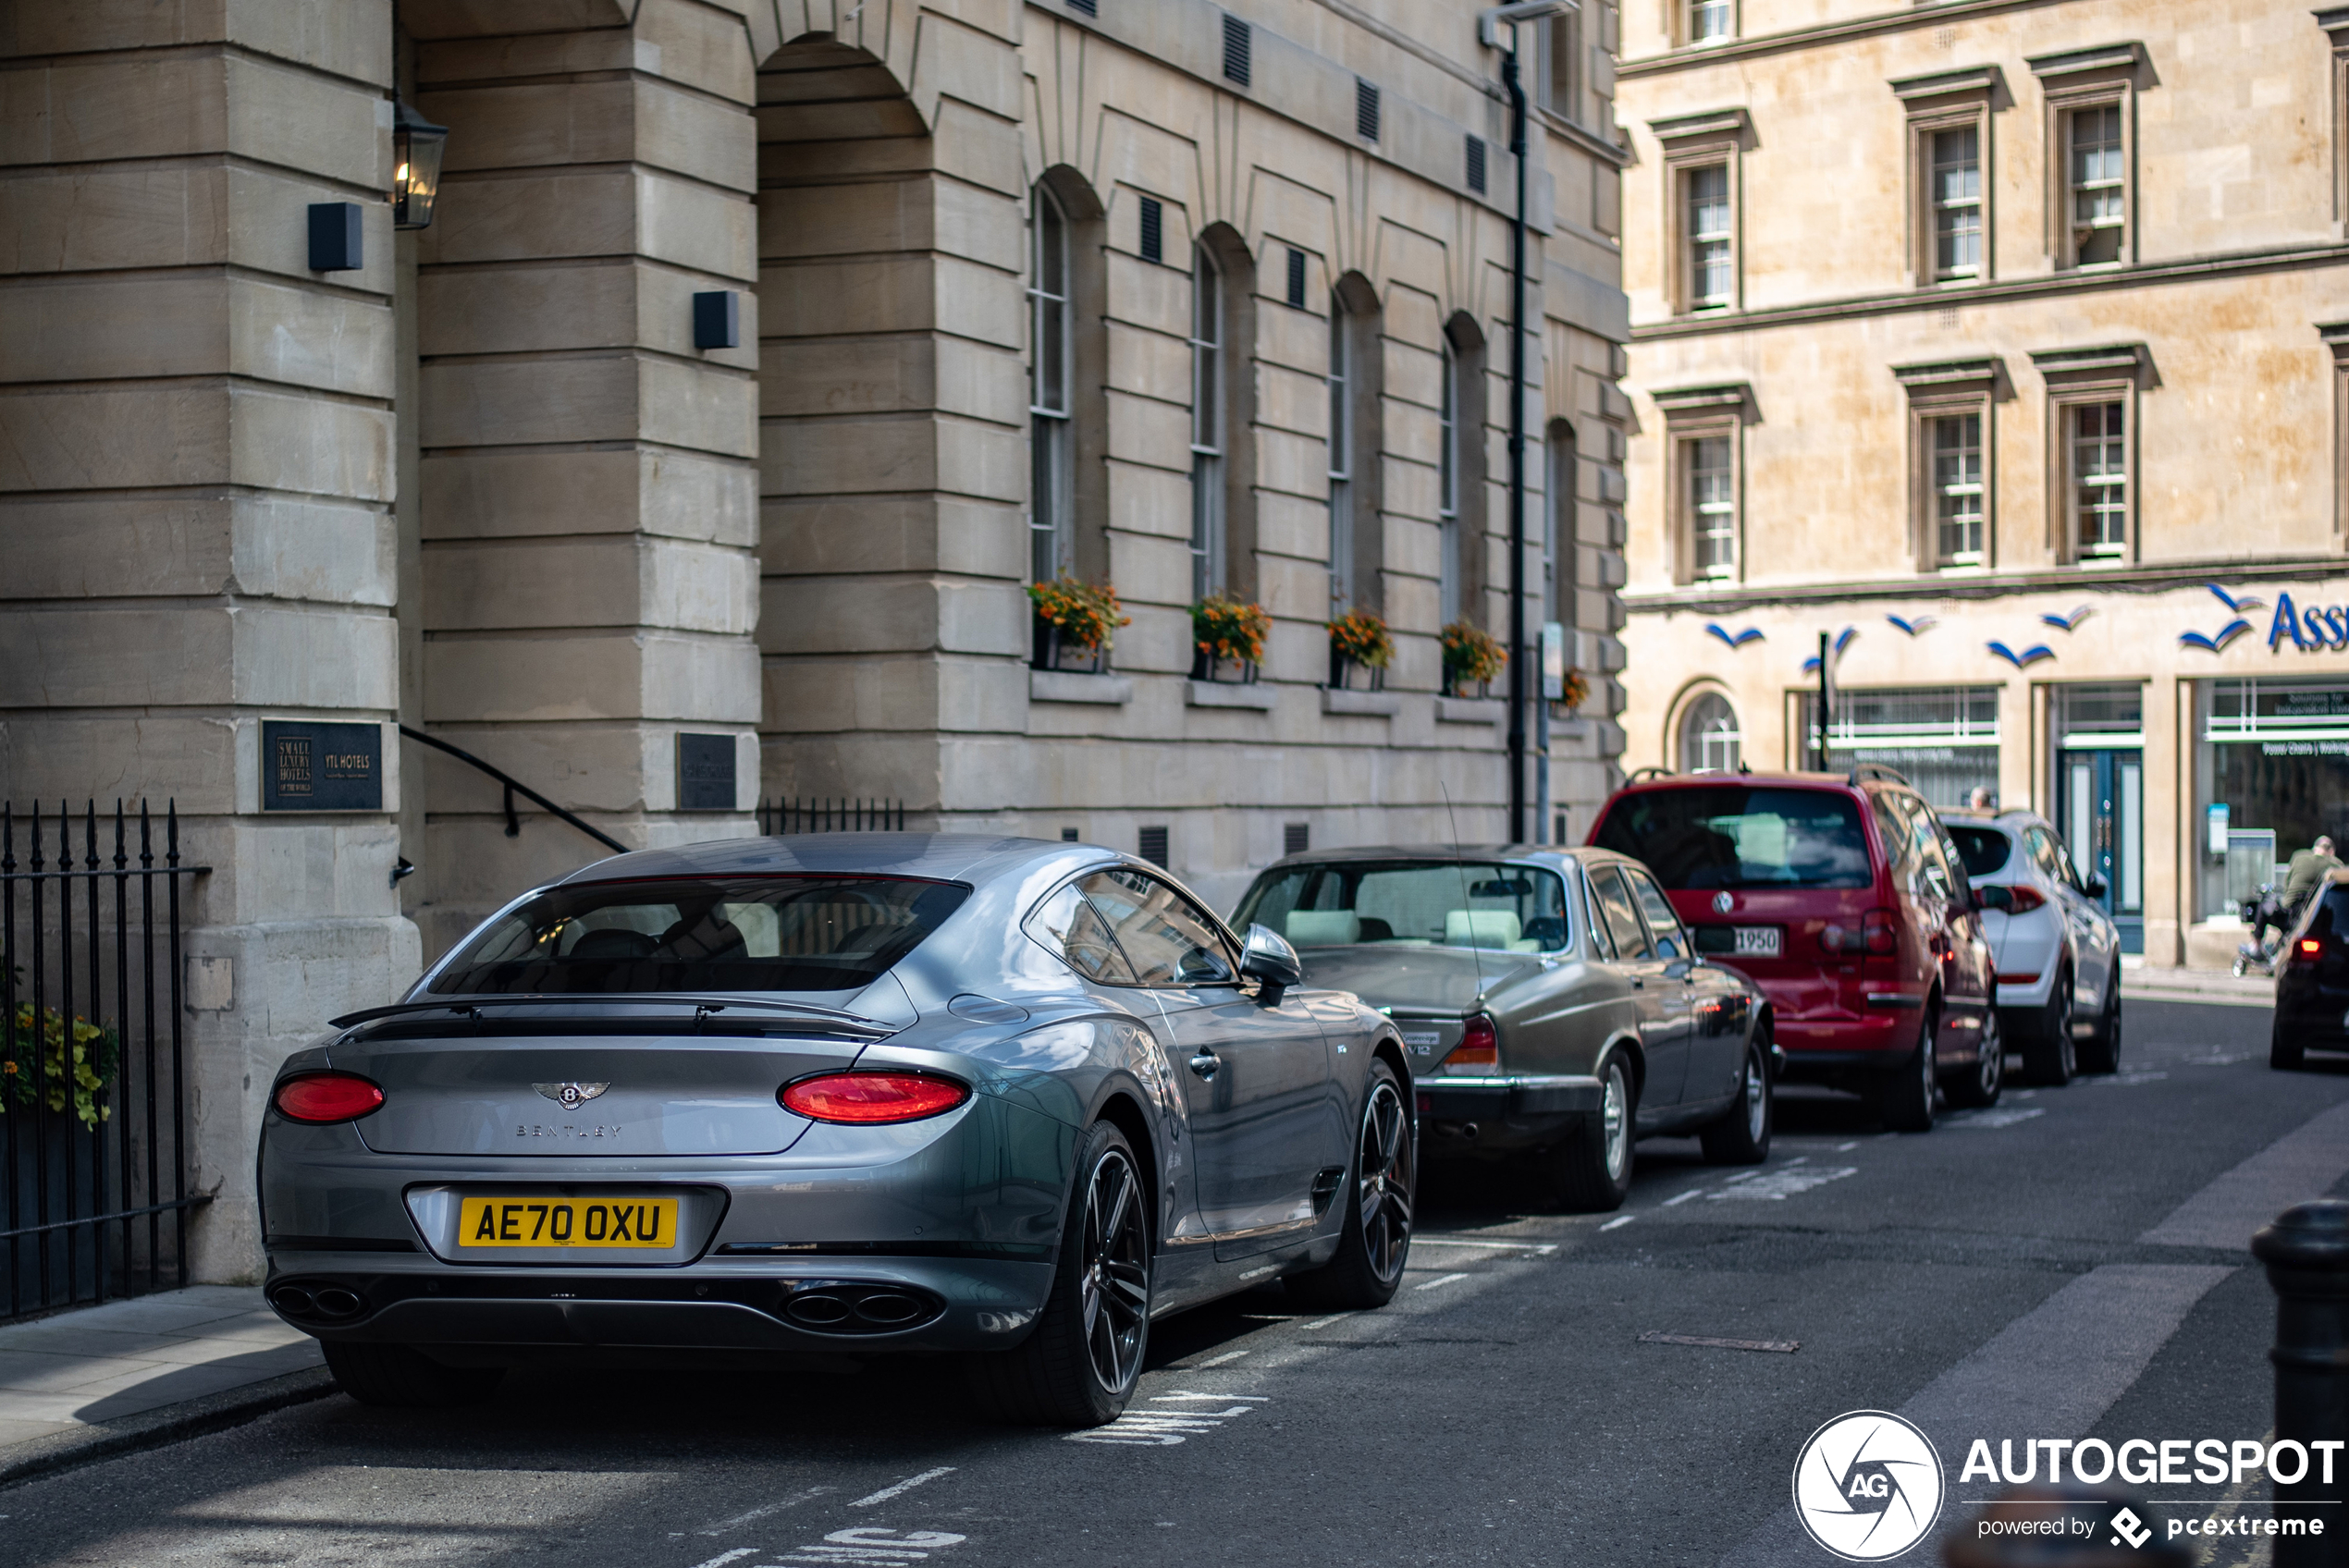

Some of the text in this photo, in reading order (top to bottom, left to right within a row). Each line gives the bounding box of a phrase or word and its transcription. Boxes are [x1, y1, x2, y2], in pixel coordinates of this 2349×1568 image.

[2269, 594, 2349, 647] Ass
[279, 741, 311, 754] SMALL
[279, 755, 310, 768] LUXURY
[325, 754, 370, 768] YTL HOTELS
[280, 768, 312, 781] HOTELS
[1738, 931, 1777, 949] 1950
[563, 1087, 576, 1102] B
[516, 1124, 622, 1137] BENTLEY
[475, 1204, 660, 1242] AE70 OXU
